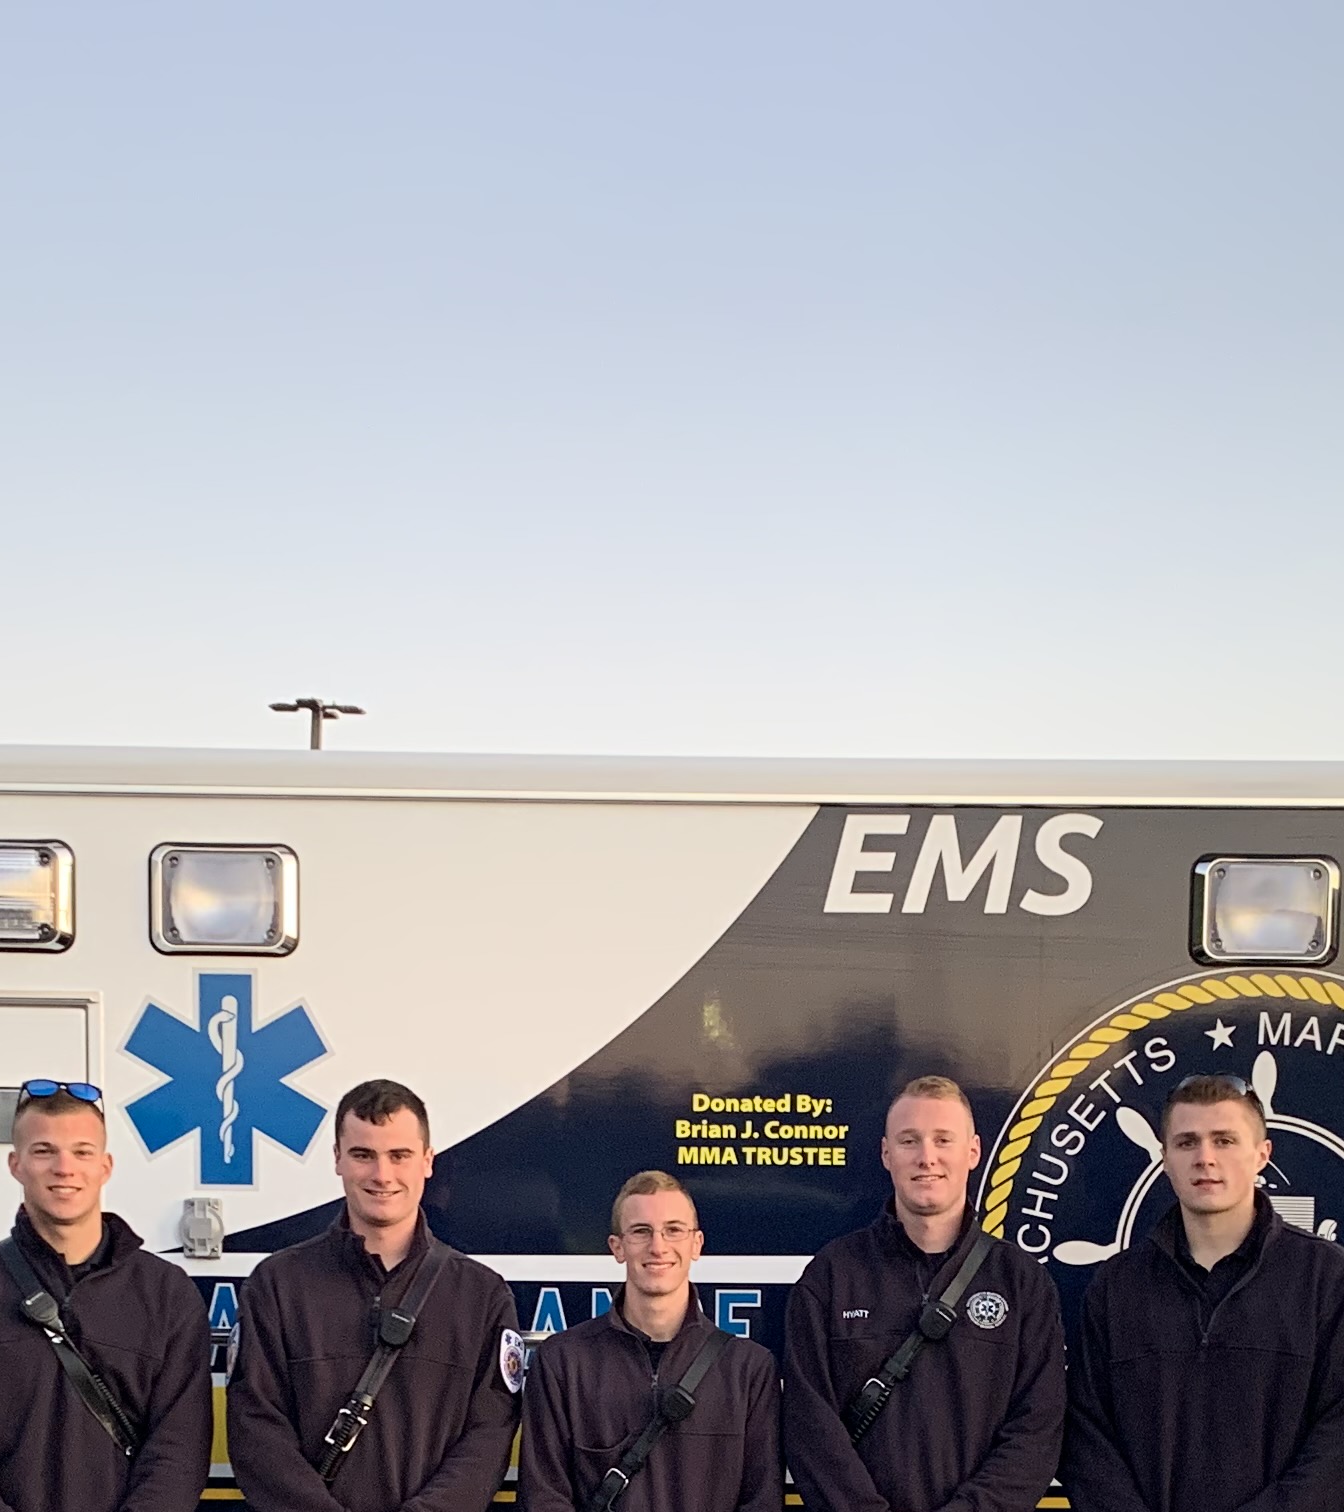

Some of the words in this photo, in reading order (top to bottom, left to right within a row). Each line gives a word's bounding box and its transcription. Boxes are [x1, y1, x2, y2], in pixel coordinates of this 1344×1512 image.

[823, 813, 1104, 916] EMS
[692, 1093, 791, 1113] Donated
[796, 1094, 833, 1118] By:
[675, 1119, 737, 1139] Brian
[740, 1120, 760, 1139] J.
[764, 1120, 849, 1140] Connor
[677, 1146, 739, 1165] MMA
[742, 1147, 846, 1166] TRUSTEE
[1017, 1037, 1176, 1263] CHUSETTS
[842, 1309, 870, 1319] HYATT
